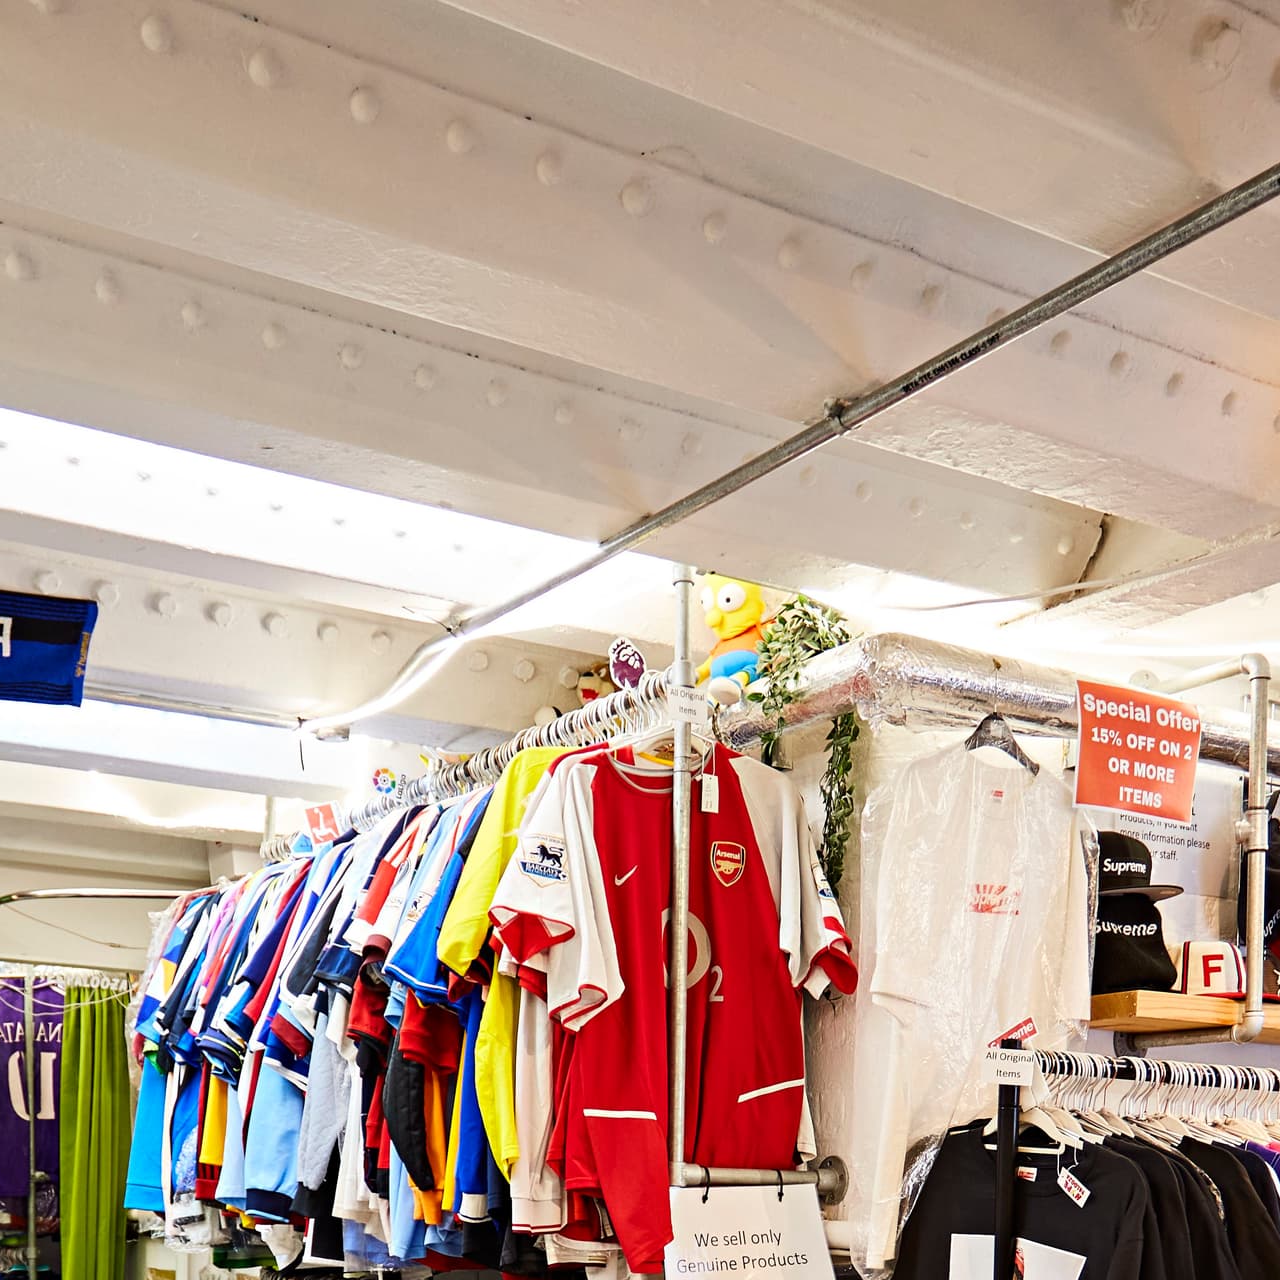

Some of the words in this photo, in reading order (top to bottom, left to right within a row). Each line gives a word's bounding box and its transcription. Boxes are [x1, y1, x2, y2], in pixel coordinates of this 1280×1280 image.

[680, 689, 705, 701] Original
[1083, 693, 1150, 723] Special
[1156, 708, 1199, 733] Offer
[1091, 726, 1122, 747] 15%
[1126, 733, 1155, 752] OFF
[1159, 740, 1180, 757] ON
[1184, 745, 1192, 760] 2
[1108, 757, 1129, 776] OR
[1134, 761, 1175, 784] MORE
[1119, 786, 1162, 809] ITEMS
[1141, 830, 1185, 846] information
[1186, 838, 1211, 850] please
[716, 849, 741, 860] Arsenal
[1159, 850, 1178, 861] staff.
[1102, 858, 1147, 876] Supreme
[1202, 954, 1224, 987] F
[986, 1051, 998, 1060] All
[1000, 1052, 1034, 1063] Original
[996, 1069, 1021, 1079] Items
[694, 1232, 719, 1248] We
[723, 1230, 746, 1246] sell
[751, 1229, 782, 1247] only
[677, 1257, 737, 1274] Genuine
[742, 1251, 808, 1270] Products
